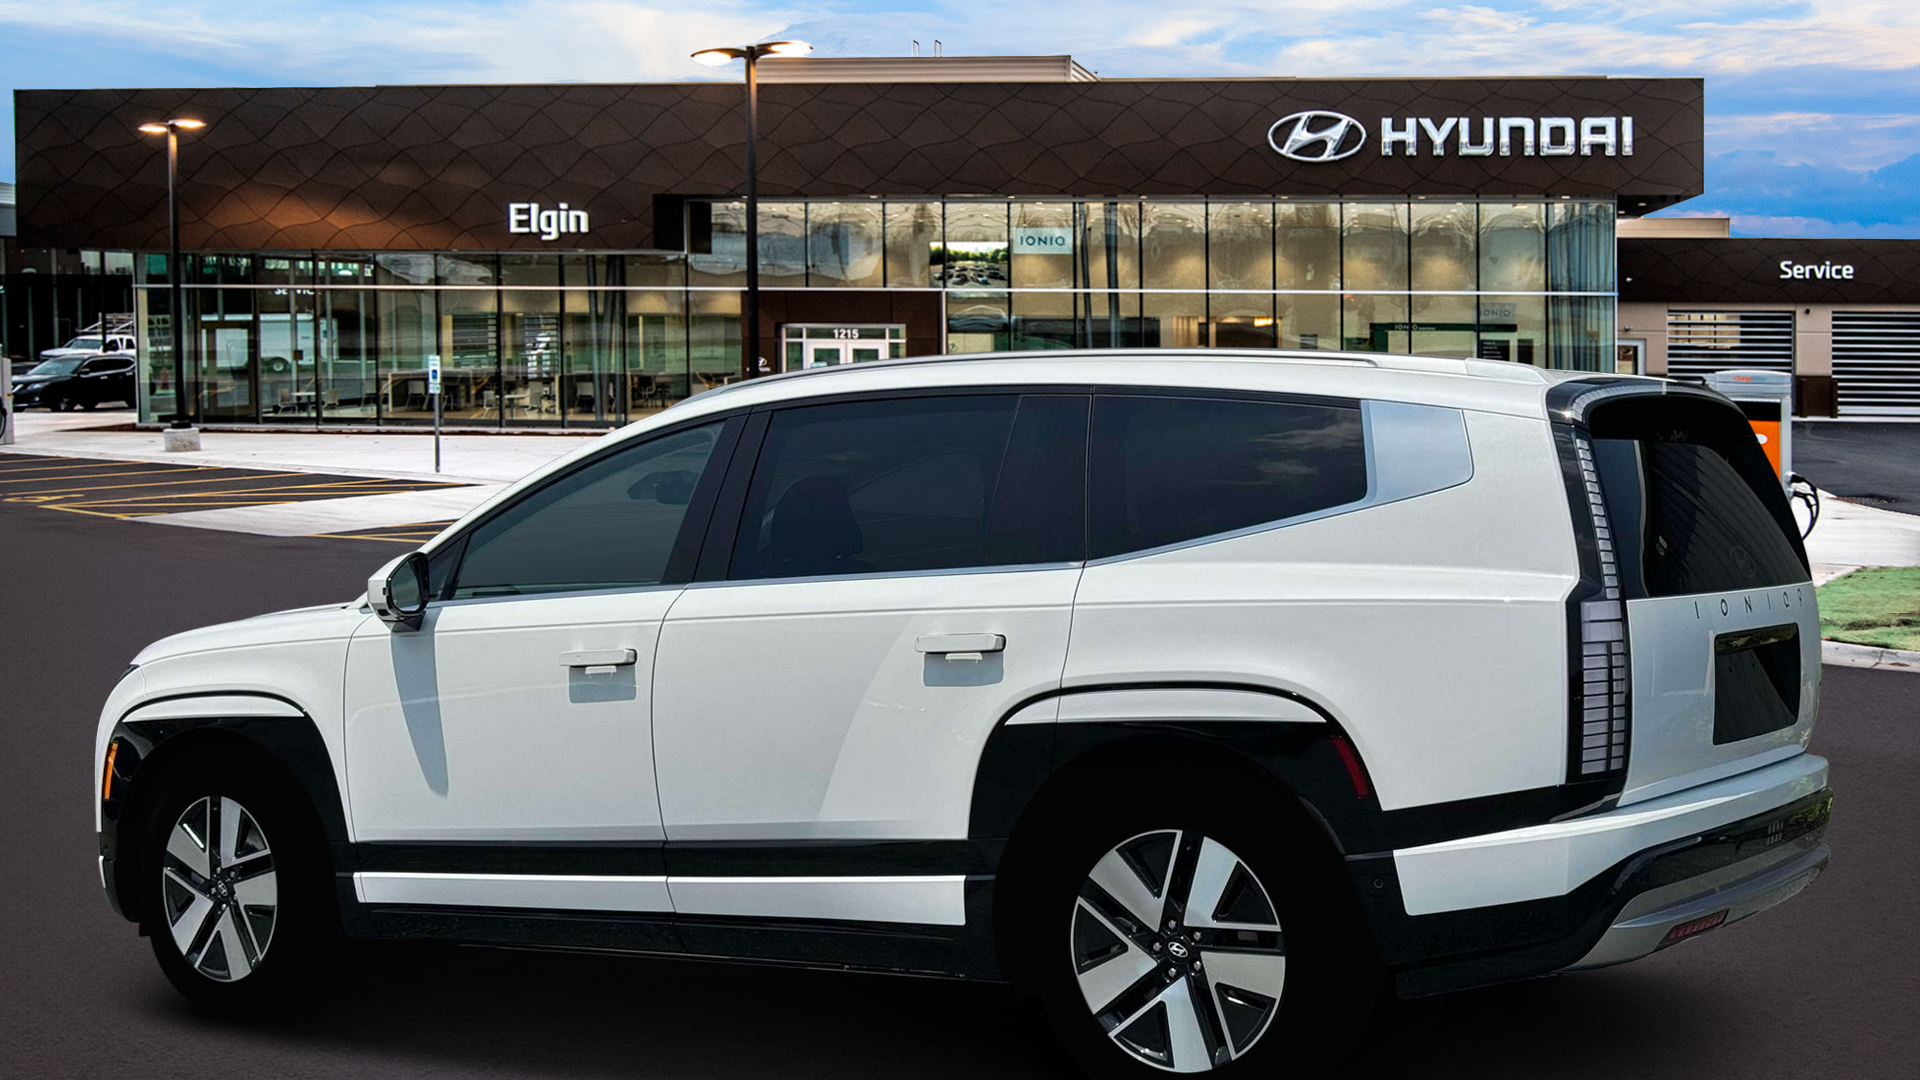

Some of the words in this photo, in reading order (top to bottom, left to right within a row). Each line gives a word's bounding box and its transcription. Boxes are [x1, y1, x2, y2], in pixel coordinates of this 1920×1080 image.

[1381, 117, 1634, 156] HYUNDAI
[508, 202, 590, 241] Elgin
[1020, 235, 1066, 247] IONIQ
[1779, 260, 1855, 280] Service
[833, 328, 860, 339] 1215
